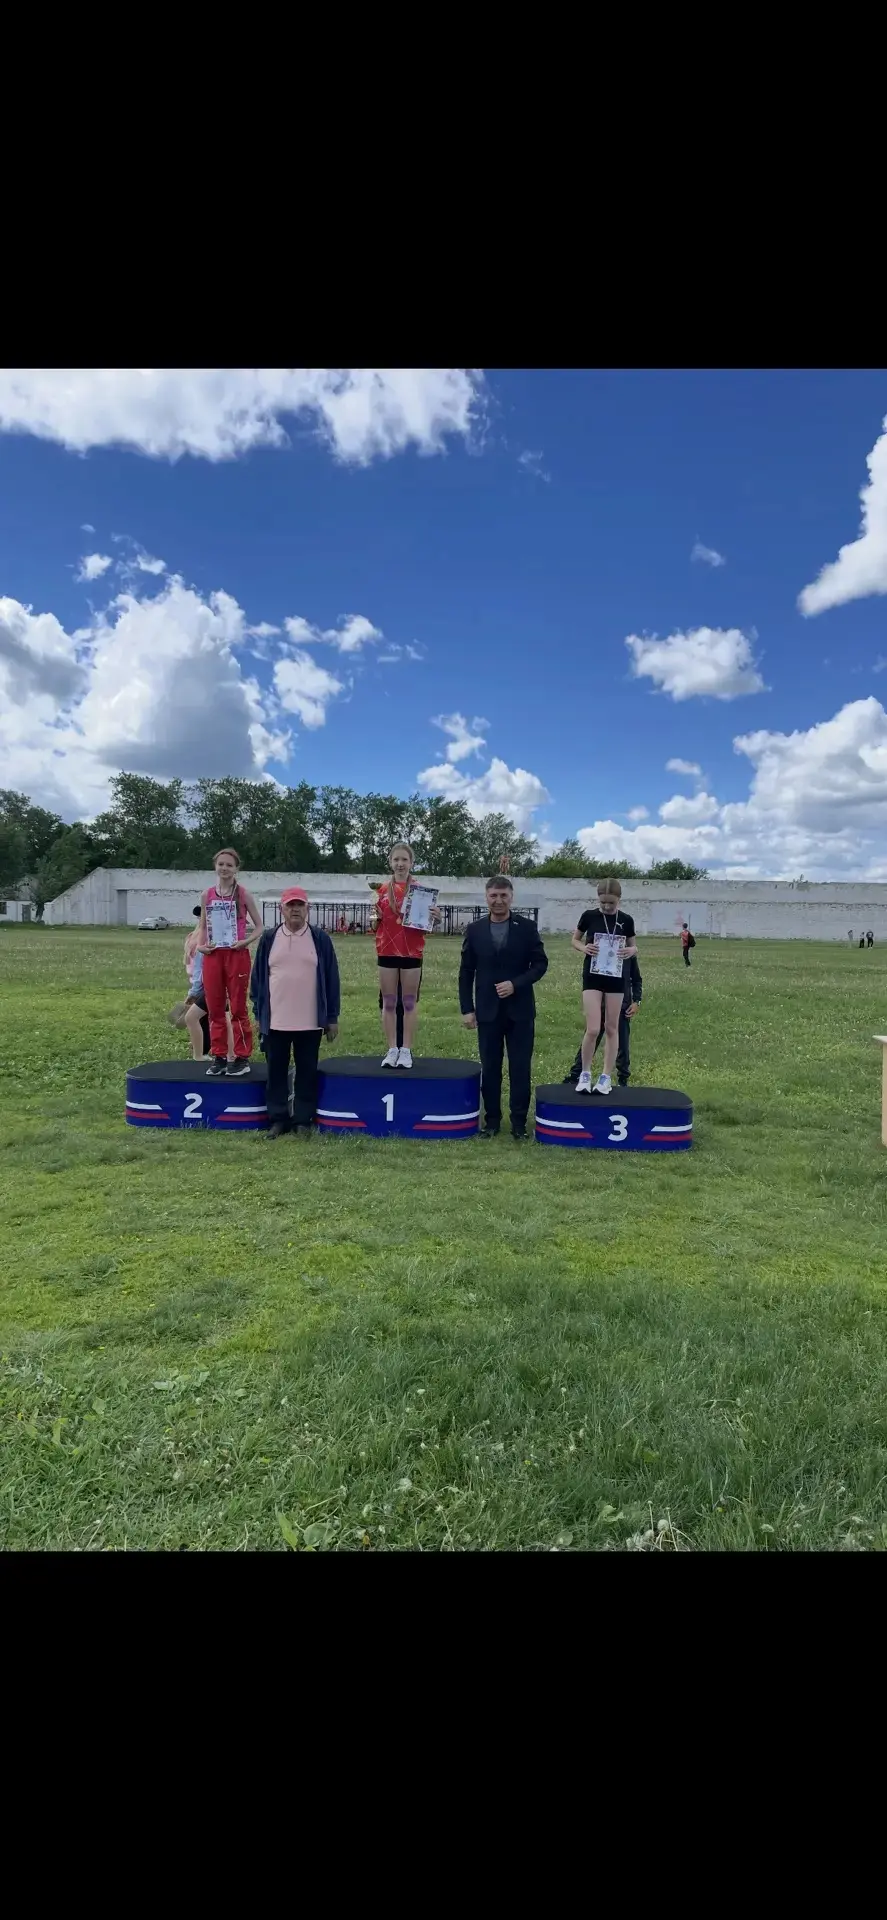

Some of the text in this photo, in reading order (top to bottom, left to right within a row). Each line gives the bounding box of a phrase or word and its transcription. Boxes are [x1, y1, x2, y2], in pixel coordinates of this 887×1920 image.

[183, 1092, 203, 1118] 2
[381, 1093, 394, 1121] 1
[607, 1114, 628, 1142] 3
